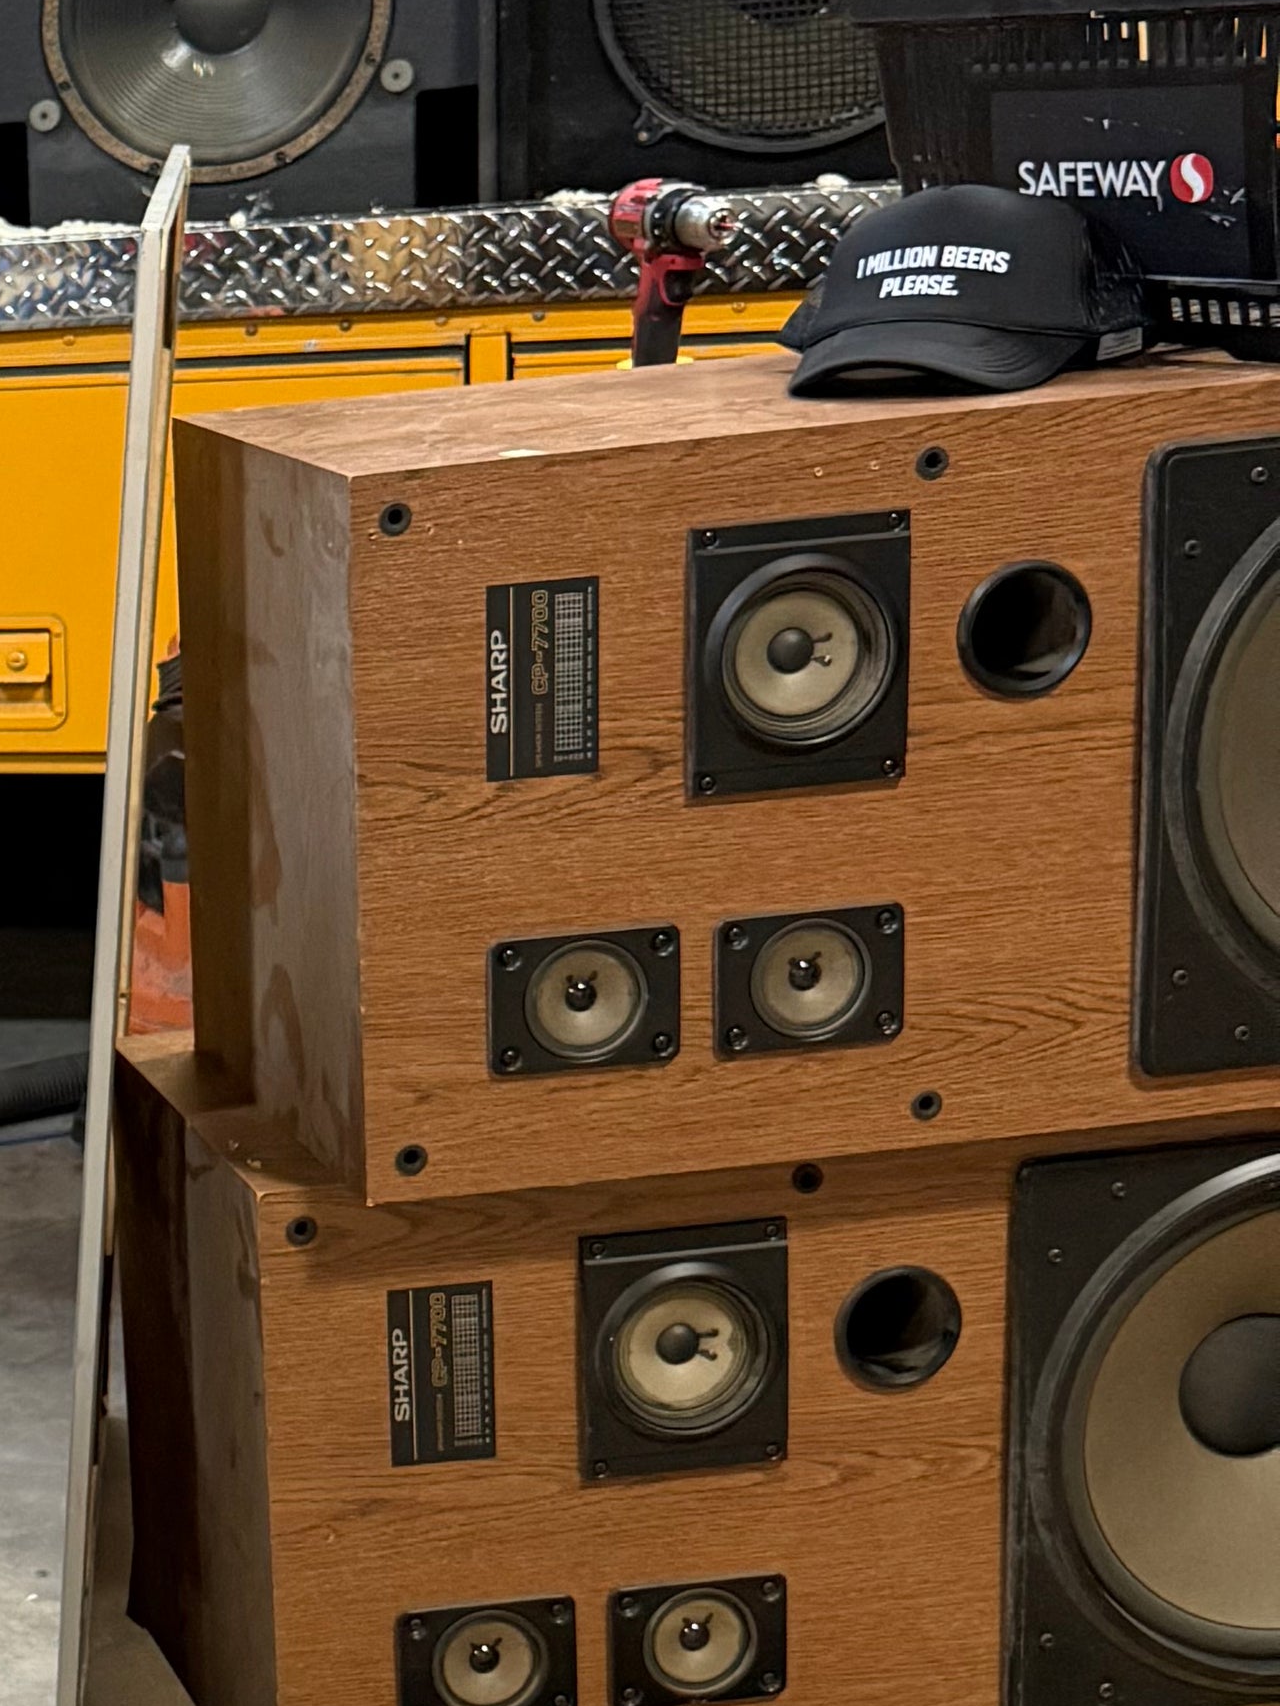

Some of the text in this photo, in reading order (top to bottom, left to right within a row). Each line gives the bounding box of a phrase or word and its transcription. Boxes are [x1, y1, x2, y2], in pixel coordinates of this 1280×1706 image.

[1018, 160, 1166, 197] SAFEWAY
[865, 245, 939, 277] MILLION
[940, 245, 1011, 274] BEERS
[878, 274, 959, 299] PLEASE.
[531, 589, 549, 696] CP-7700
[490, 629, 508, 734] SHARP
[391, 1327, 411, 1423] SHARP
